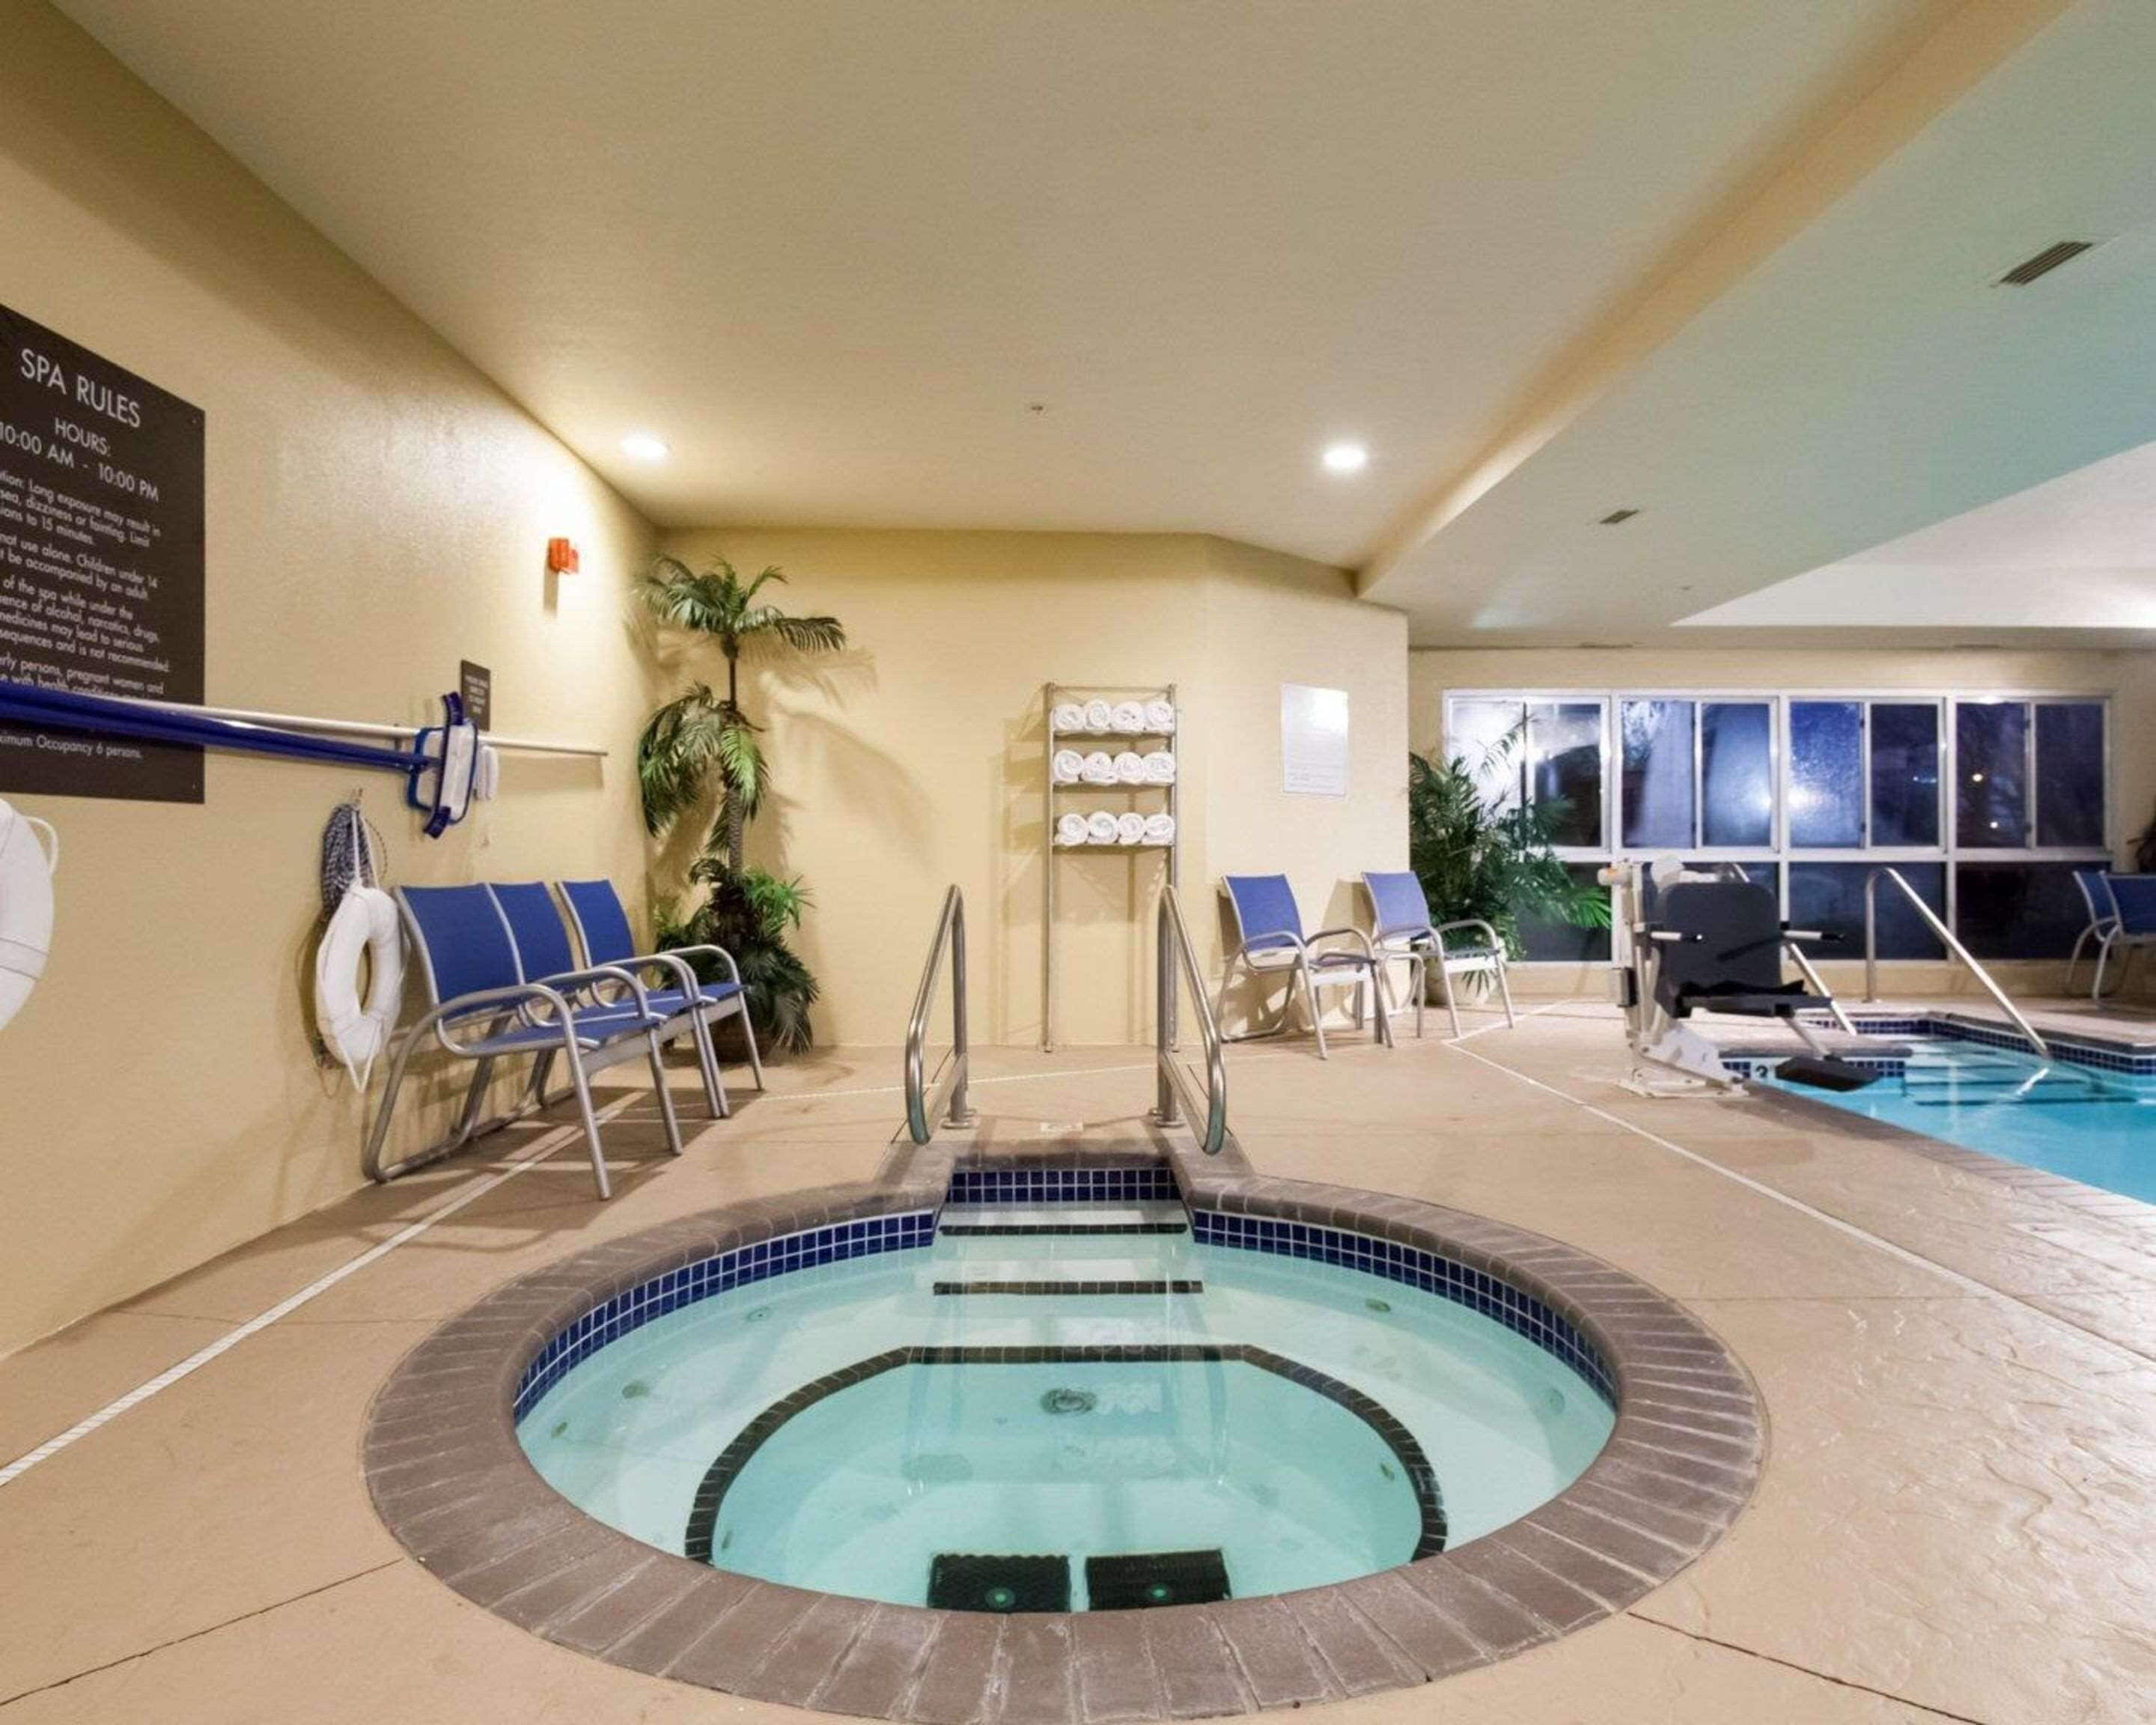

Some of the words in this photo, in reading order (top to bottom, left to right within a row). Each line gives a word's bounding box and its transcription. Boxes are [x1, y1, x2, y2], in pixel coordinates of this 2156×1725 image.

[21, 348, 67, 395] SPA
[77, 375, 141, 428] RULES
[55, 418, 111, 457] HOURS:
[0, 422, 42, 454] 10:00
[47, 445, 74, 468] AM
[99, 463, 135, 491] 10:00
[139, 480, 159, 502] PM
[25, 494, 73, 522] dizziness
[76, 516, 86, 526] or
[28, 478, 54, 505] Long
[58, 494, 101, 517] exposure
[104, 511, 124, 526] may
[26, 513, 37, 526] to
[42, 515, 53, 532] 15
[8, 547, 22, 565] be
[25, 558, 93, 585] accompanied
[96, 573, 108, 591] by
[111, 582, 123, 593] an
[20, 540, 38, 553] use
[76, 553, 116, 576] Children
[118, 569, 144, 584] under
[3, 574, 15, 590] of
[18, 577, 35, 594] the
[38, 588, 57, 603] spa
[61, 591, 87, 608] while
[89, 599, 116, 615] under
[120, 605, 133, 621] the
[31, 599, 43, 612] of
[46, 601, 84, 626] alcohol,
[50, 624, 73, 639] may
[76, 624, 97, 642] lead
[100, 633, 111, 645] to
[113, 638, 143, 653] serious
[55, 639, 76, 654] and
[79, 642, 87, 656] is
[89, 648, 105, 659] not
[67, 669, 110, 684] pregnant
[113, 678, 144, 692] women
[147, 681, 164, 695] and
[36, 734, 94, 757] Occupancy
[96, 742, 103, 755] 6
